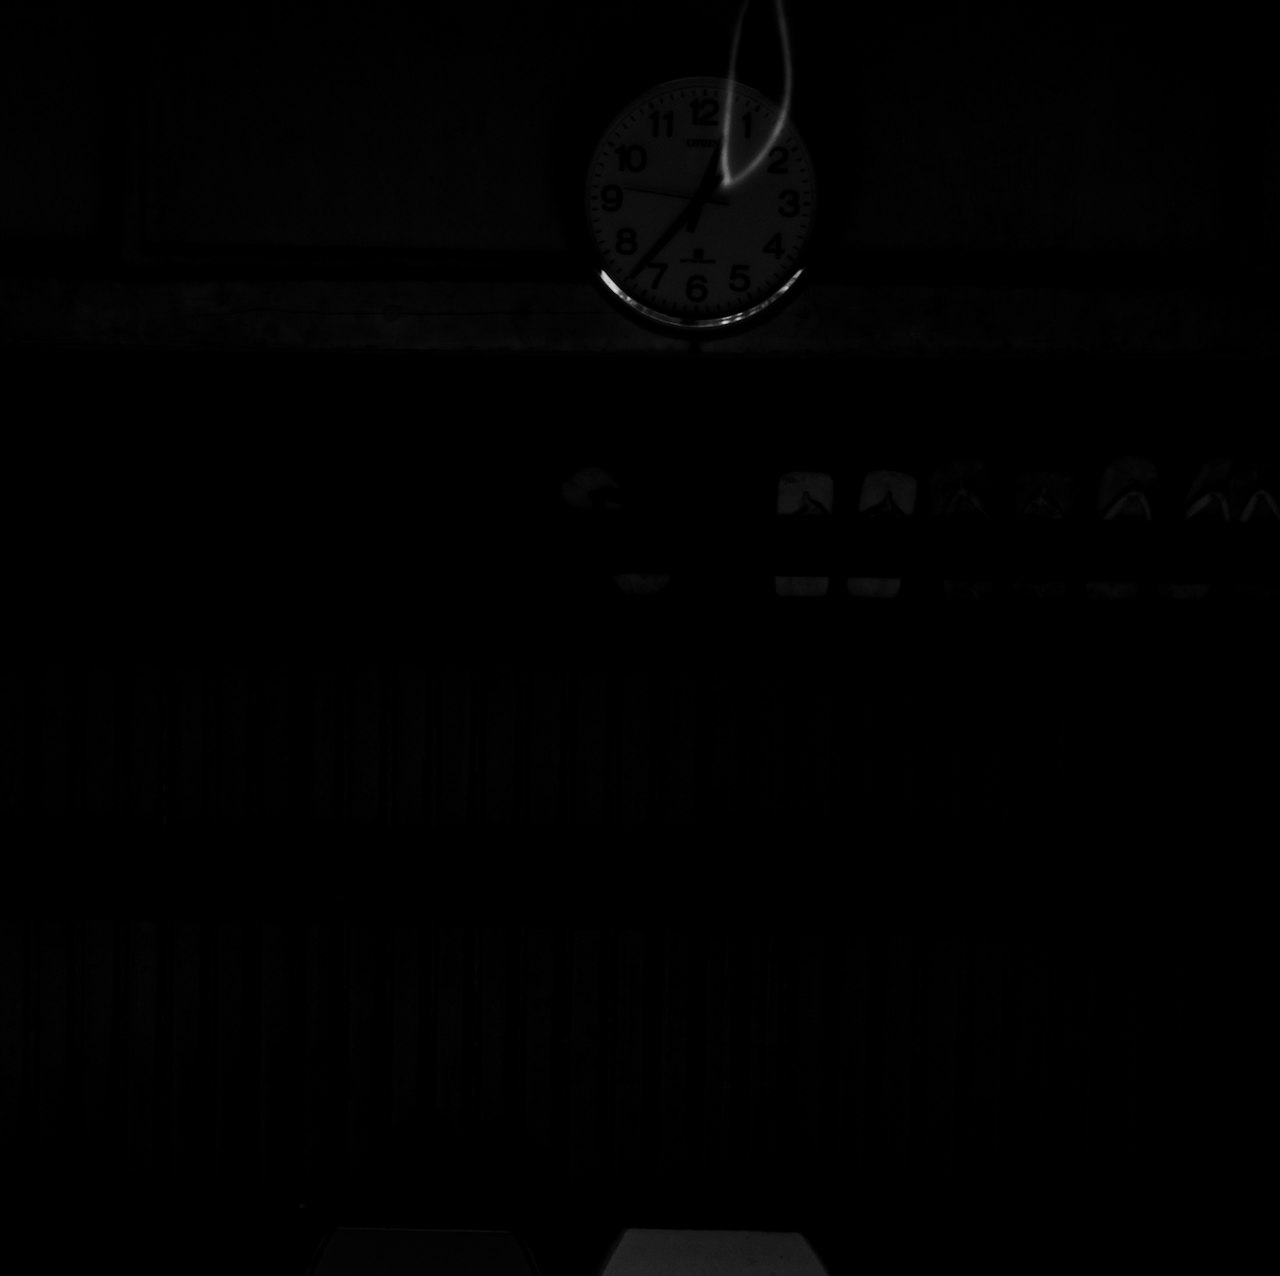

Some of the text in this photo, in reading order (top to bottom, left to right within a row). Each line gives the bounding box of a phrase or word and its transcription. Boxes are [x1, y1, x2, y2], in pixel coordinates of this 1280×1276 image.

[649, 110, 673, 137] 11
[690, 99, 719, 126] 12
[742, 111, 752, 139] 1
[615, 144, 647, 172] 10
[767, 147, 788, 174] 2
[601, 184, 623, 212] 9
[778, 189, 800, 217] 3
[616, 228, 637, 254] 8
[763, 233, 785, 259] 4
[647, 263, 668, 289] 7
[686, 275, 707, 301] 6
[729, 265, 750, 292] 5
